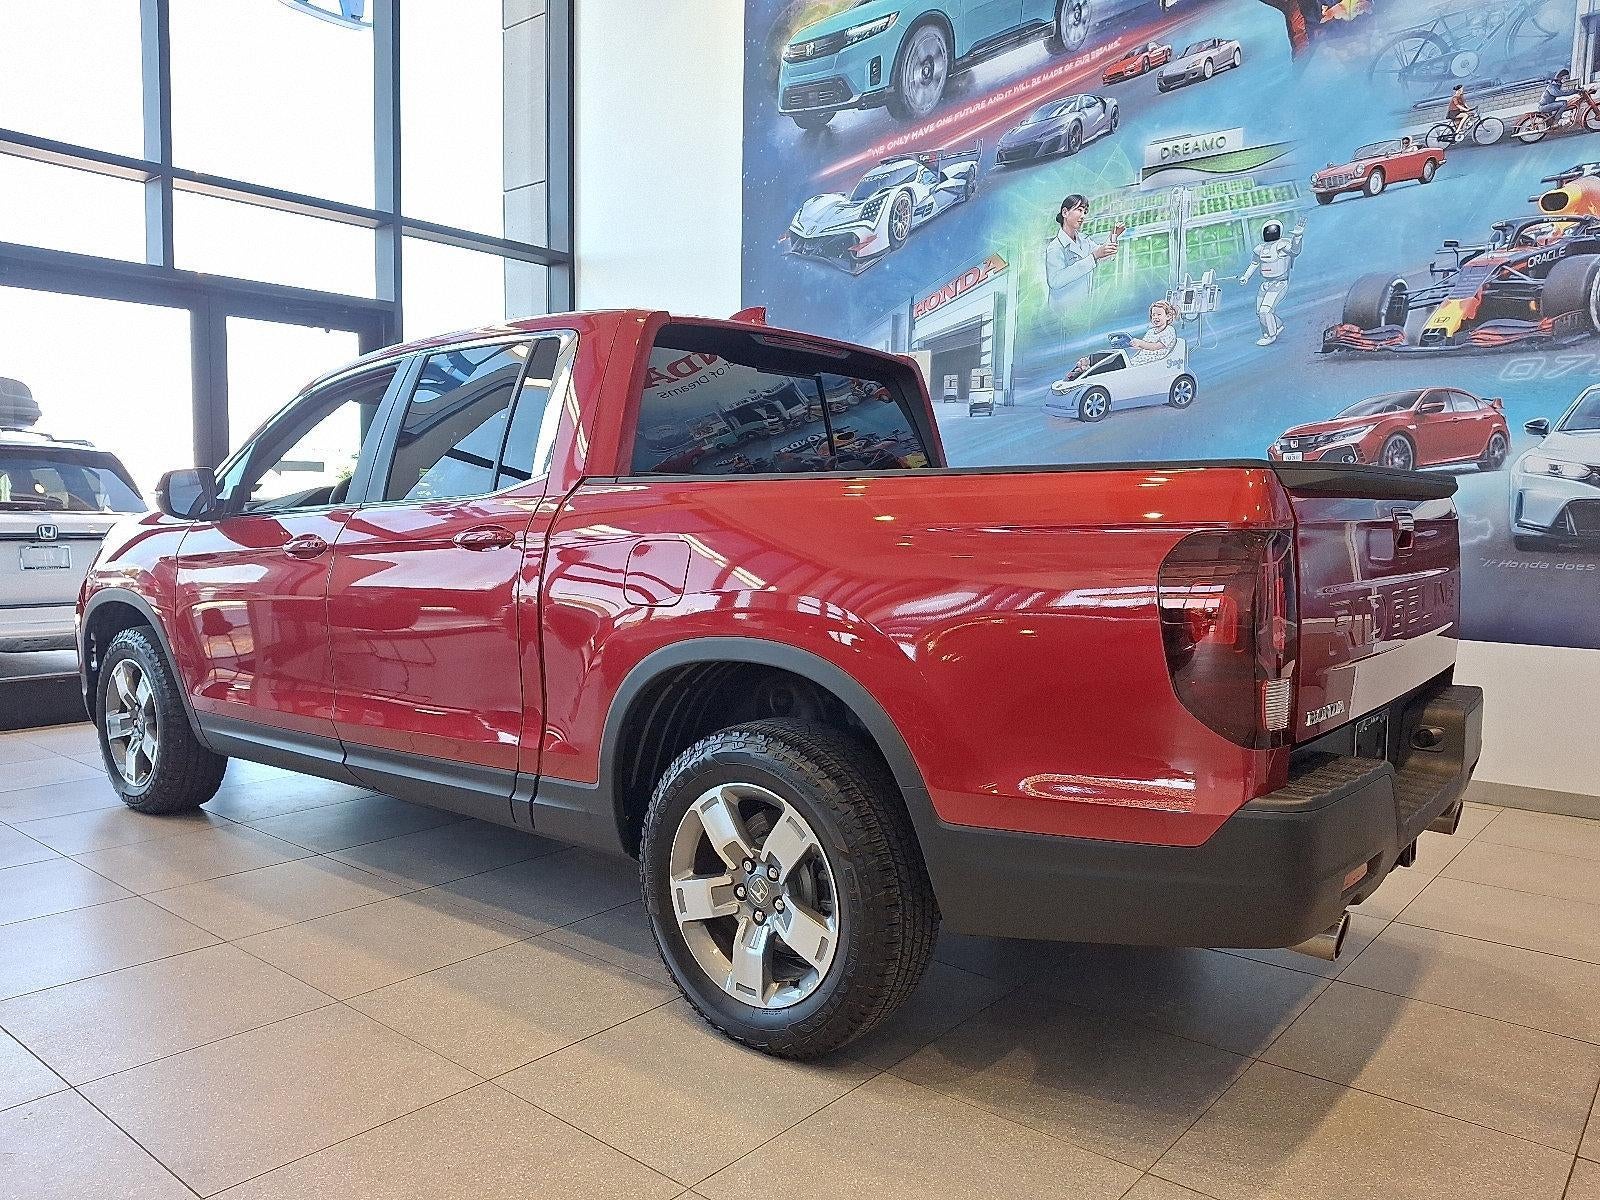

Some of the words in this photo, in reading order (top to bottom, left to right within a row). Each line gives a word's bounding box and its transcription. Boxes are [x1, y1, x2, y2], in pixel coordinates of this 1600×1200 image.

[887, 133, 911, 150] ONLY
[911, 123, 936, 140] HAVE
[935, 115, 955, 128] ONE
[953, 100, 986, 121] FUTURE
[987, 93, 1005, 106] AND
[1004, 89, 1013, 99] IT
[1013, 82, 1031, 94] WILL
[1031, 76, 1042, 87] BE
[1041, 66, 1064, 80] MADE
[1064, 60, 1075, 73] OF
[1160, 136, 1226, 160] DREAMO
[1527, 245, 1566, 268] ORACLE
[912, 251, 1010, 320] HONDA
[1304, 699, 1346, 727] HONDA
